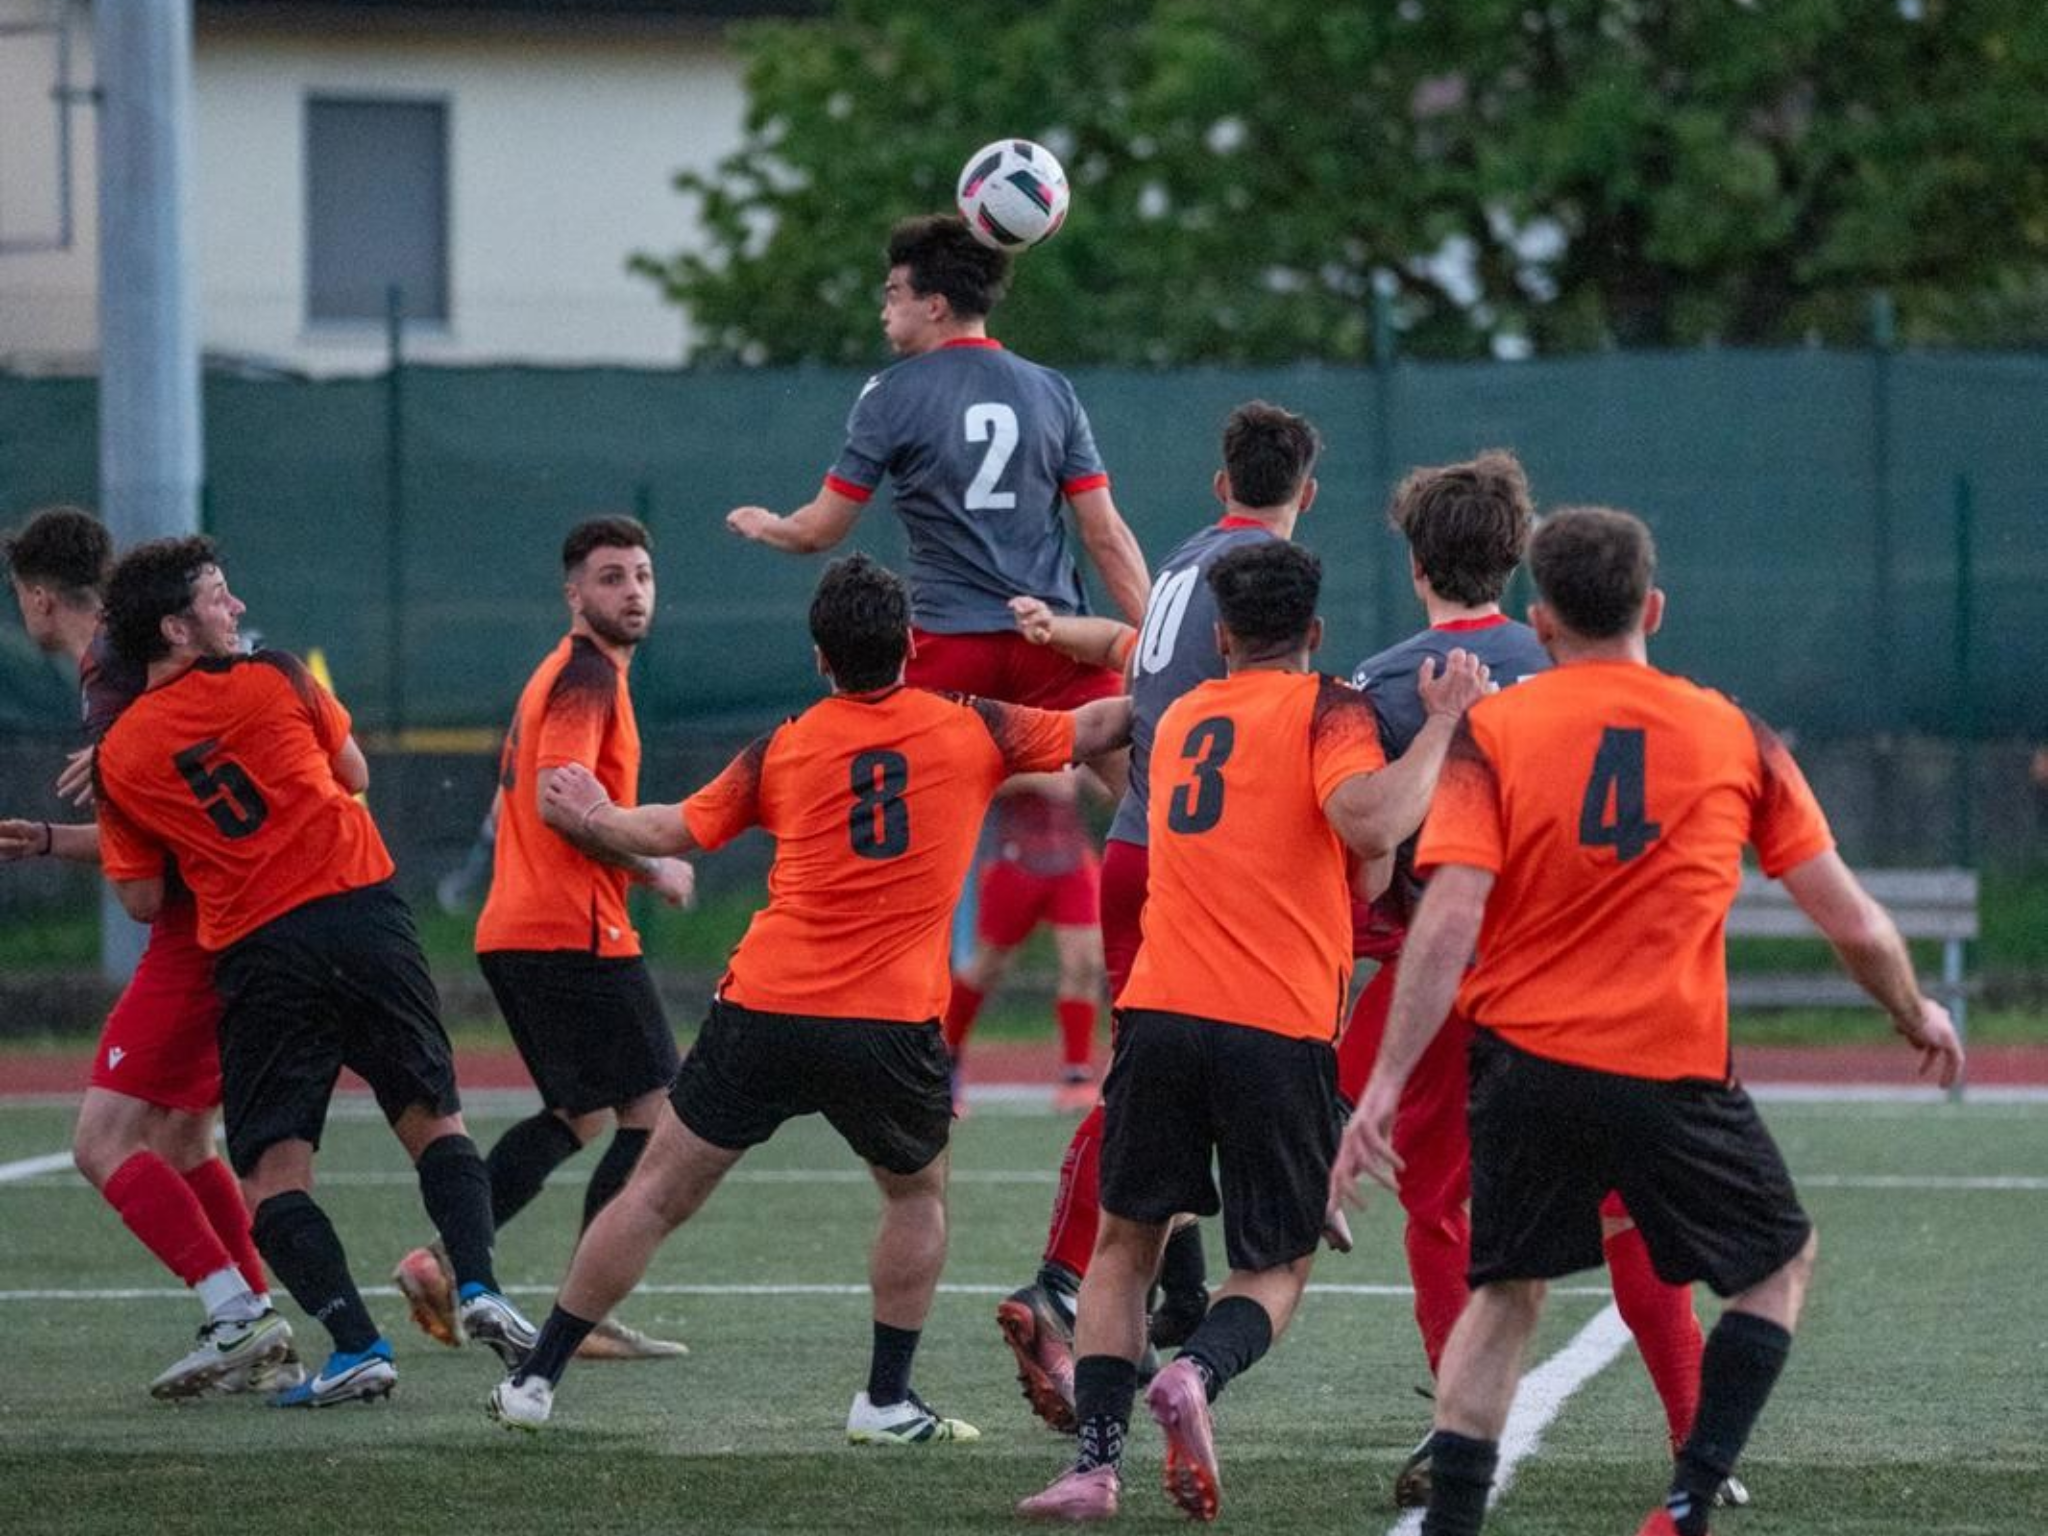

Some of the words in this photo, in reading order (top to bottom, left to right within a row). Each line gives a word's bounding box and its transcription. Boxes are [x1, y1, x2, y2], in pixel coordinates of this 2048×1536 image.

[964, 402, 1019, 510] 2
[1133, 565, 1199, 678] 10
[173, 736, 269, 838] 5
[849, 749, 909, 859] 8
[1167, 716, 1234, 834] 3
[1578, 728, 1661, 862] 4
